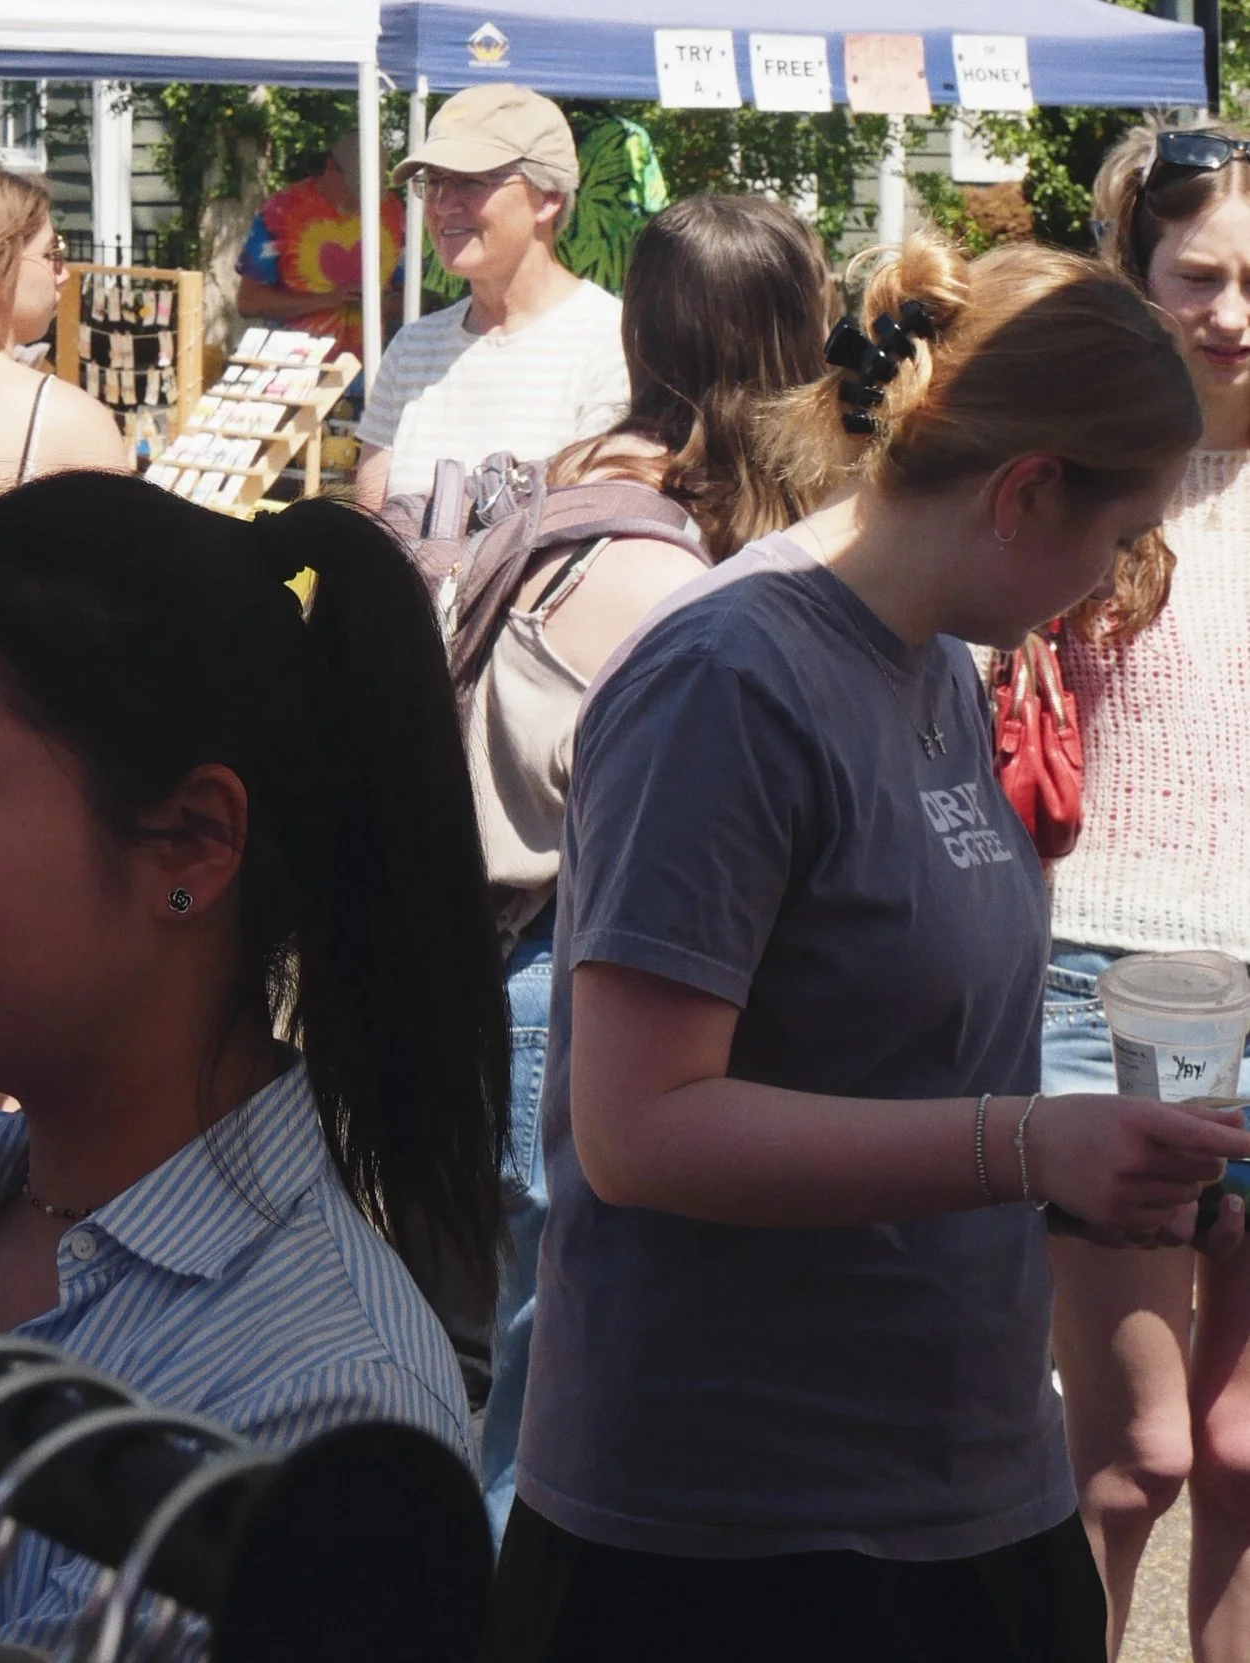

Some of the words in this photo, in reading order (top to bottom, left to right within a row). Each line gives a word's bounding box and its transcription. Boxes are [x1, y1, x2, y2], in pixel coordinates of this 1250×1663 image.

[676, 45, 713, 62] TRY
[764, 59, 816, 78] FREE
[963, 67, 1021, 83] HONEY
[694, 80, 705, 95] A
[1172, 1055, 1207, 1081] YAY!
